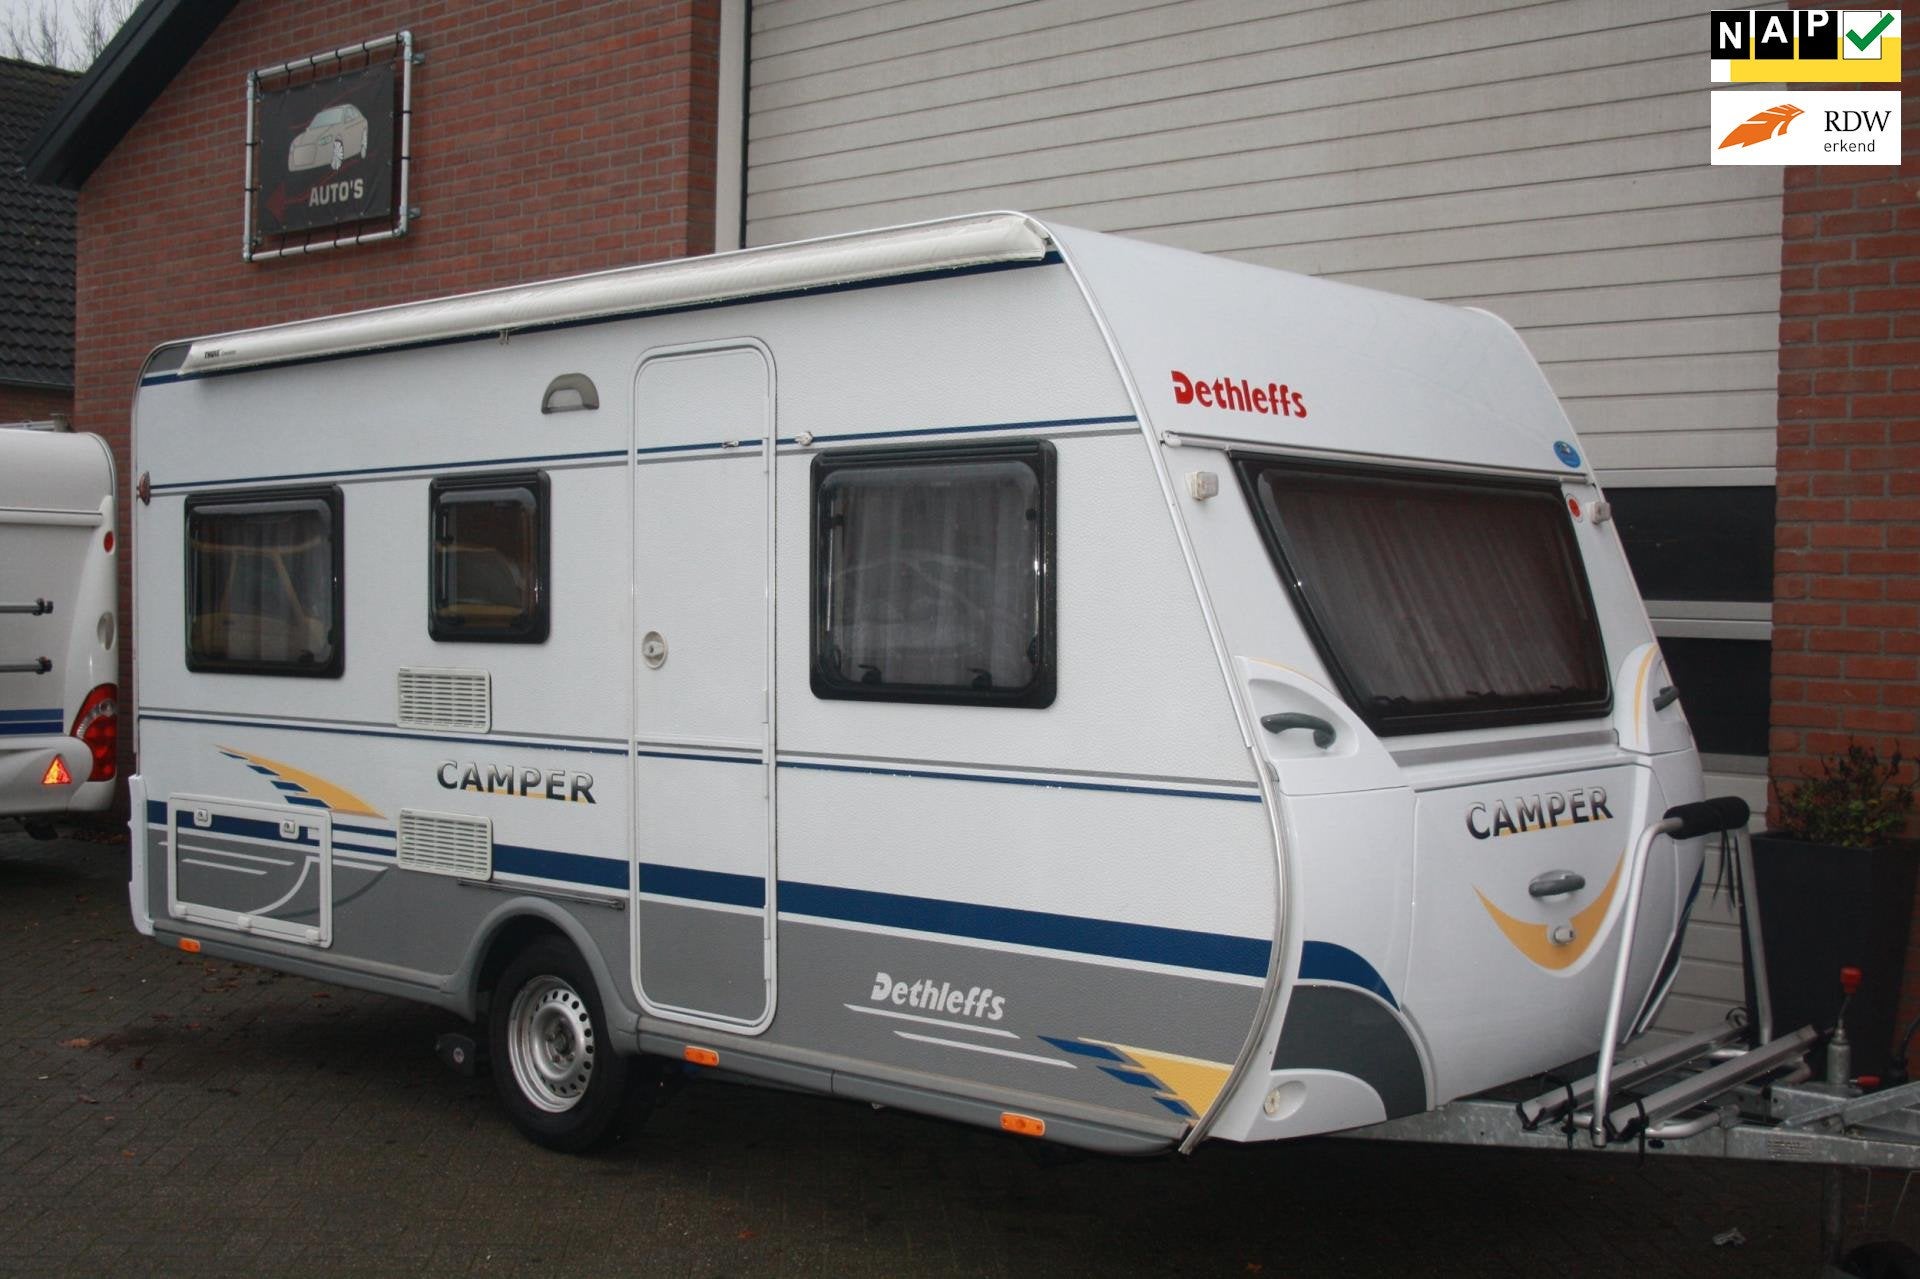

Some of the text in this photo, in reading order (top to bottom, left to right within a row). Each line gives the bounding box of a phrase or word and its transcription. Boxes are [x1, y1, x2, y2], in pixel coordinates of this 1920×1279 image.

[308, 178, 364, 207] AUTO'S
[1170, 370, 1308, 419] Dethleffs
[436, 759, 597, 804] CAMPER
[1465, 786, 1614, 840] CAMPER
[870, 971, 1006, 1021] Dethleffs
